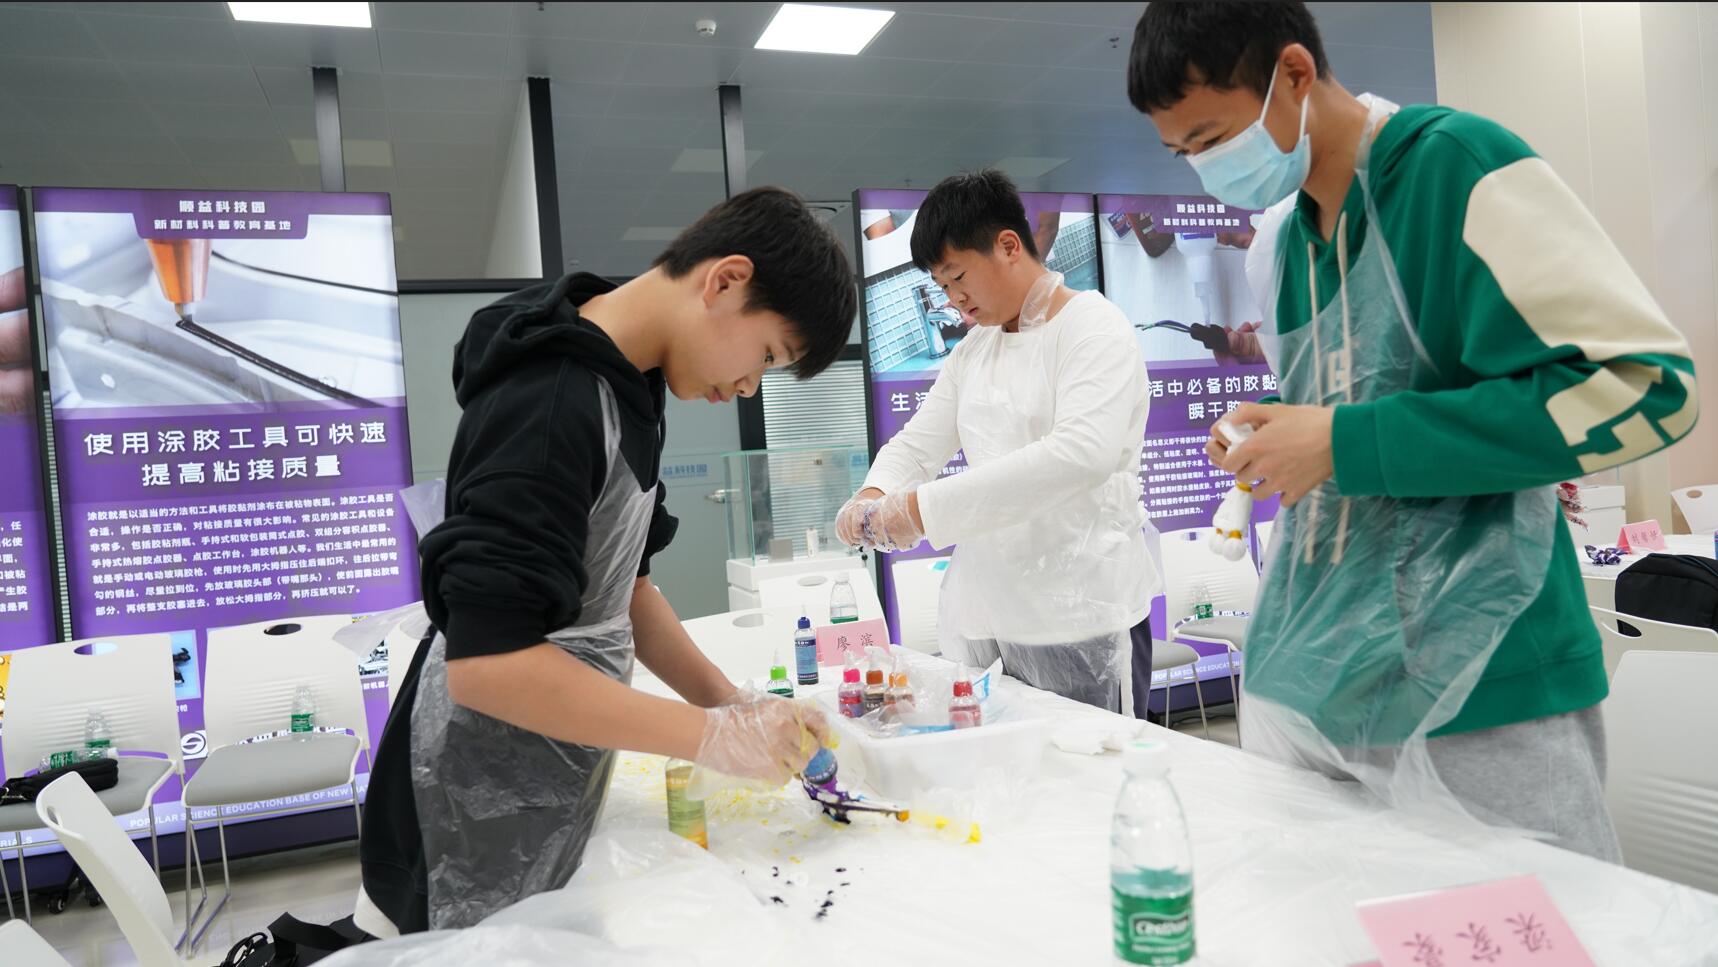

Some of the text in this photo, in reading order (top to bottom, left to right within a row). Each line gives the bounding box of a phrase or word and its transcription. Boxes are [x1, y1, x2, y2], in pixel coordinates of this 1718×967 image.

[84, 421, 386, 457] 使用涂胶工具可快速
[141, 455, 341, 487] 提高粘接质量
[226, 798, 284, 815] EDUCATION
[285, 795, 312, 807] BASE
[312, 791, 326, 802] OF
[327, 787, 349, 800] NEW
